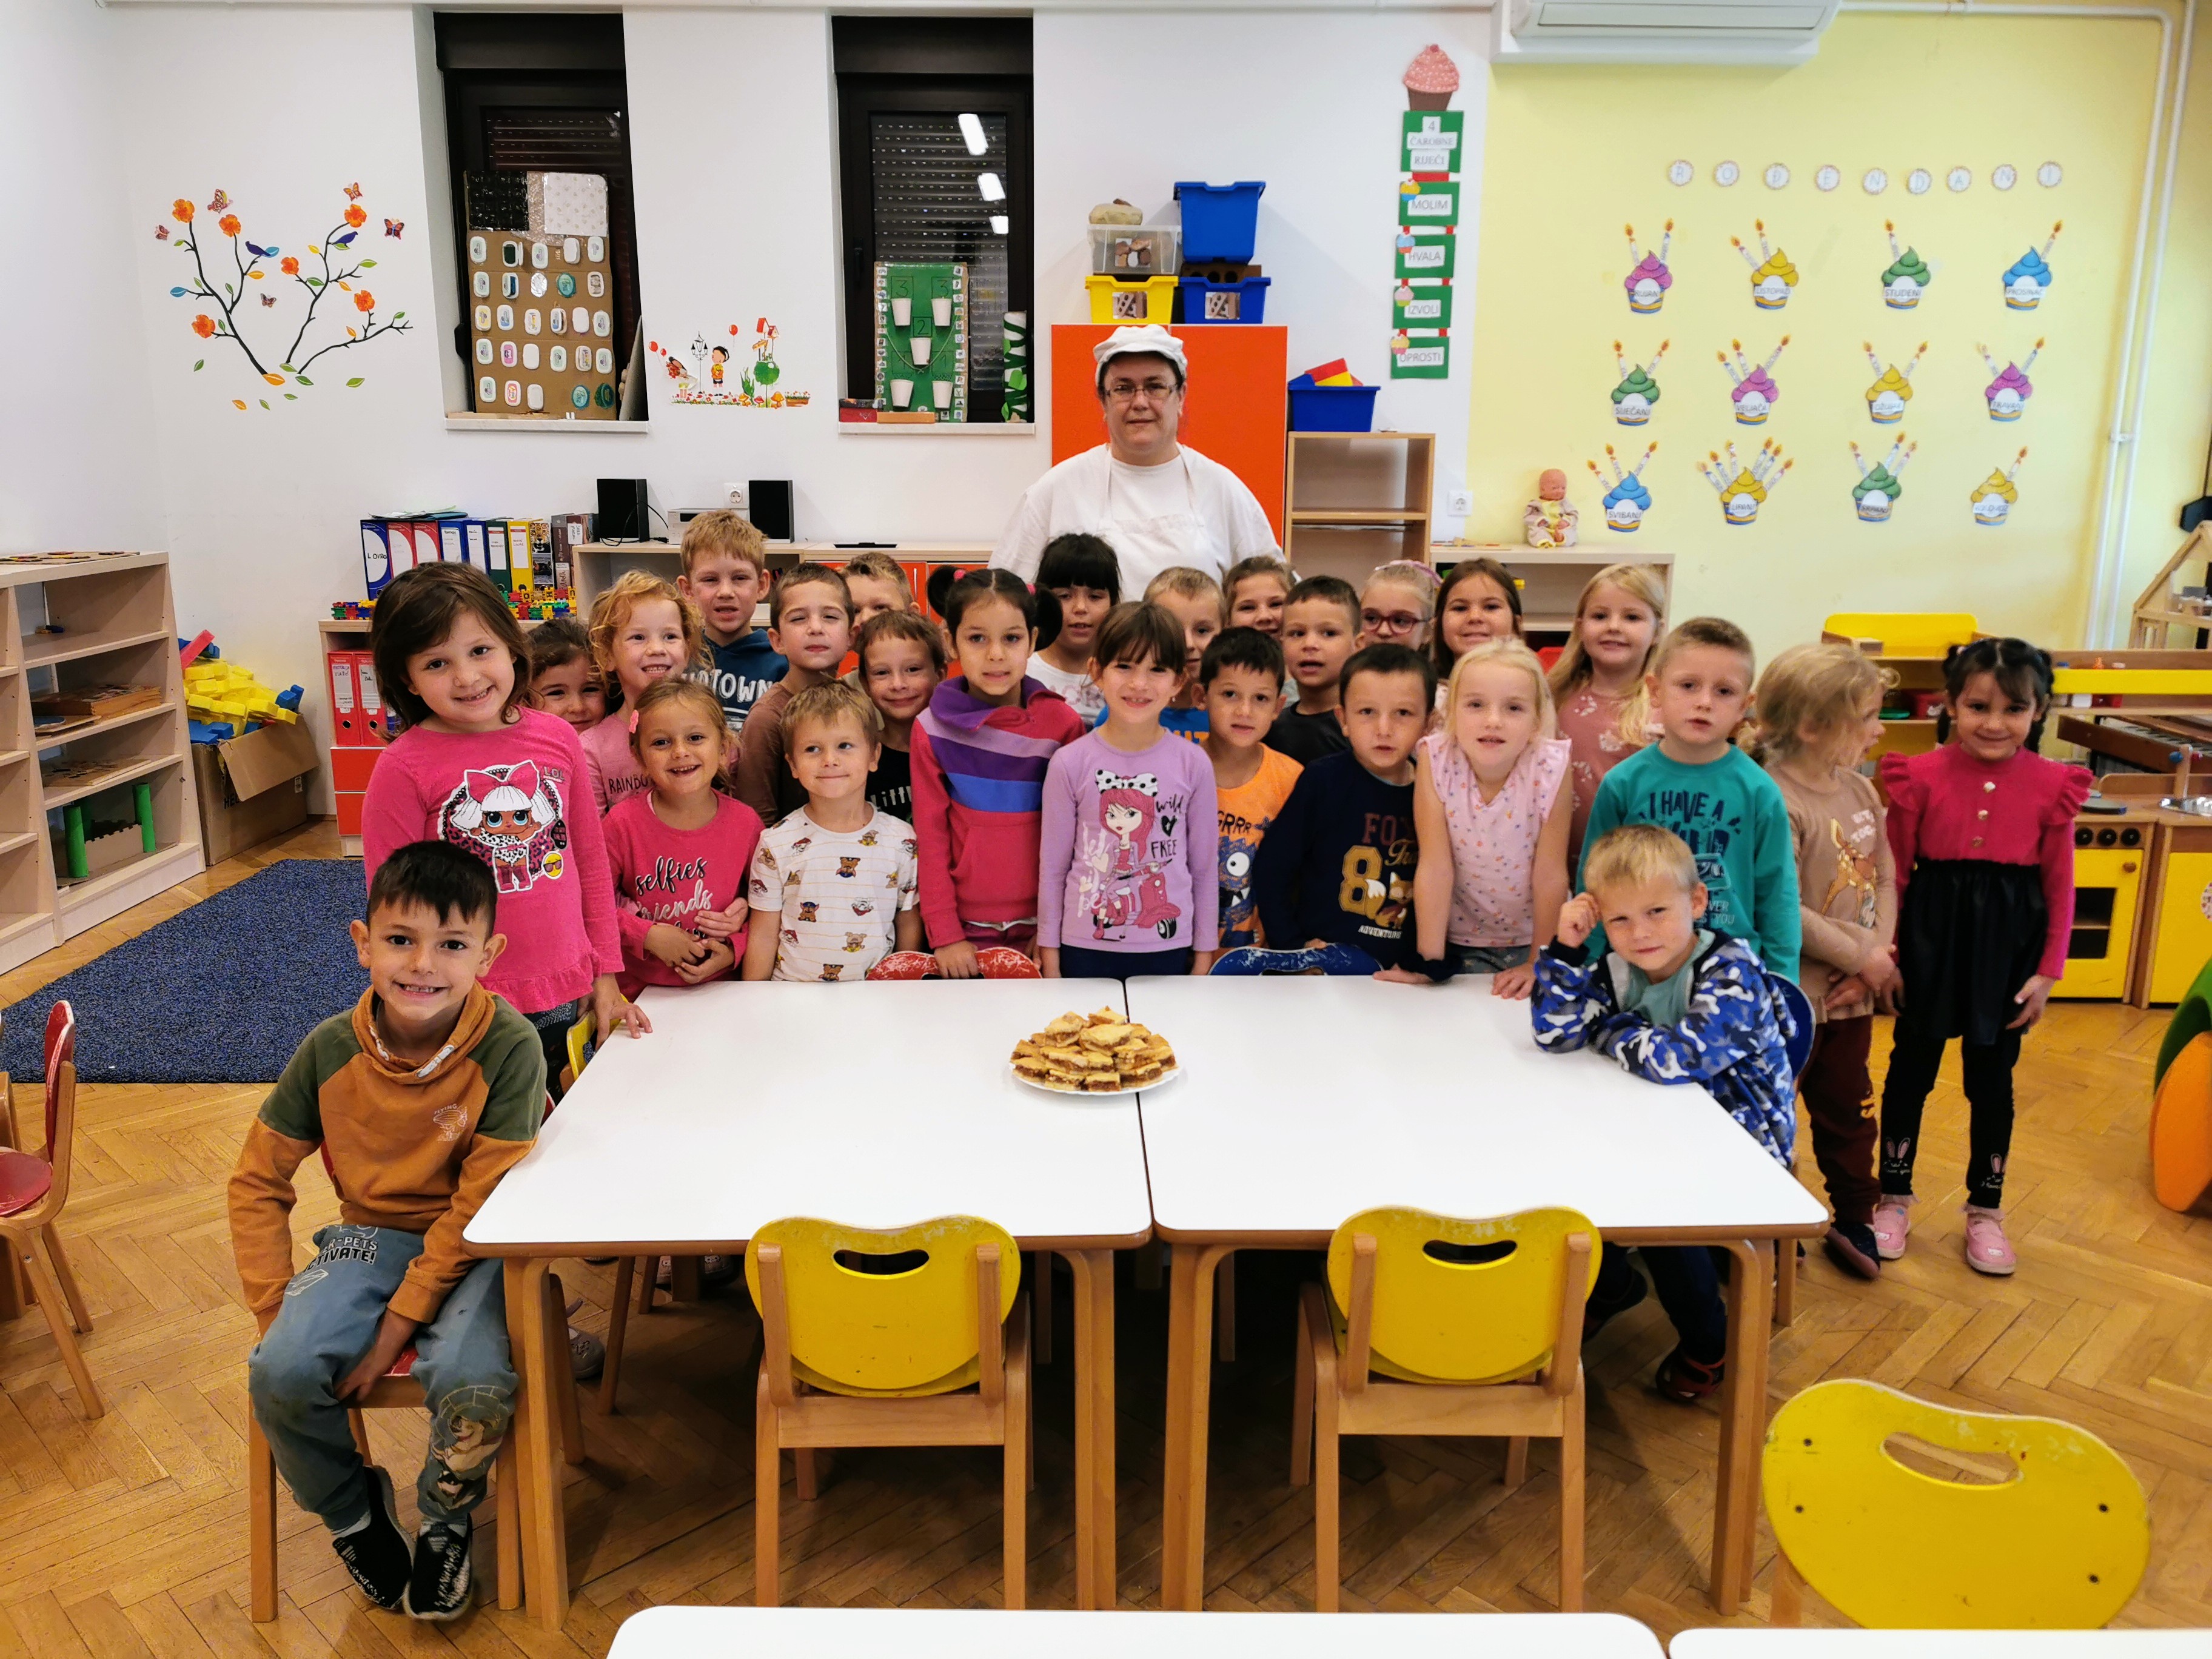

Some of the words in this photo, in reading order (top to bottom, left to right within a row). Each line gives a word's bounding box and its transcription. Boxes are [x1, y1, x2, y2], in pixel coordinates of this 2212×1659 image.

[1428, 121, 1435, 132] 4
[1412, 199, 1448, 210] MOLIM
[1408, 250, 1441, 261] HVALA
[896, 280, 908, 298] 3
[939, 280, 949, 298] 3
[1407, 304, 1439, 315] IZVOLI
[917, 319, 929, 335] 2
[1399, 352, 1441, 363] OPROSTI
[543, 766, 565, 780] LOL
[608, 774, 649, 794] RAINBO
[870, 785, 911, 810] Littl
[1661, 789, 1709, 823] HAVE
[1712, 800, 1724, 822] A
[1151, 839, 1178, 859] FREE
[635, 855, 708, 896] selfies
[304, 1247, 377, 1272] CTIVATE!
